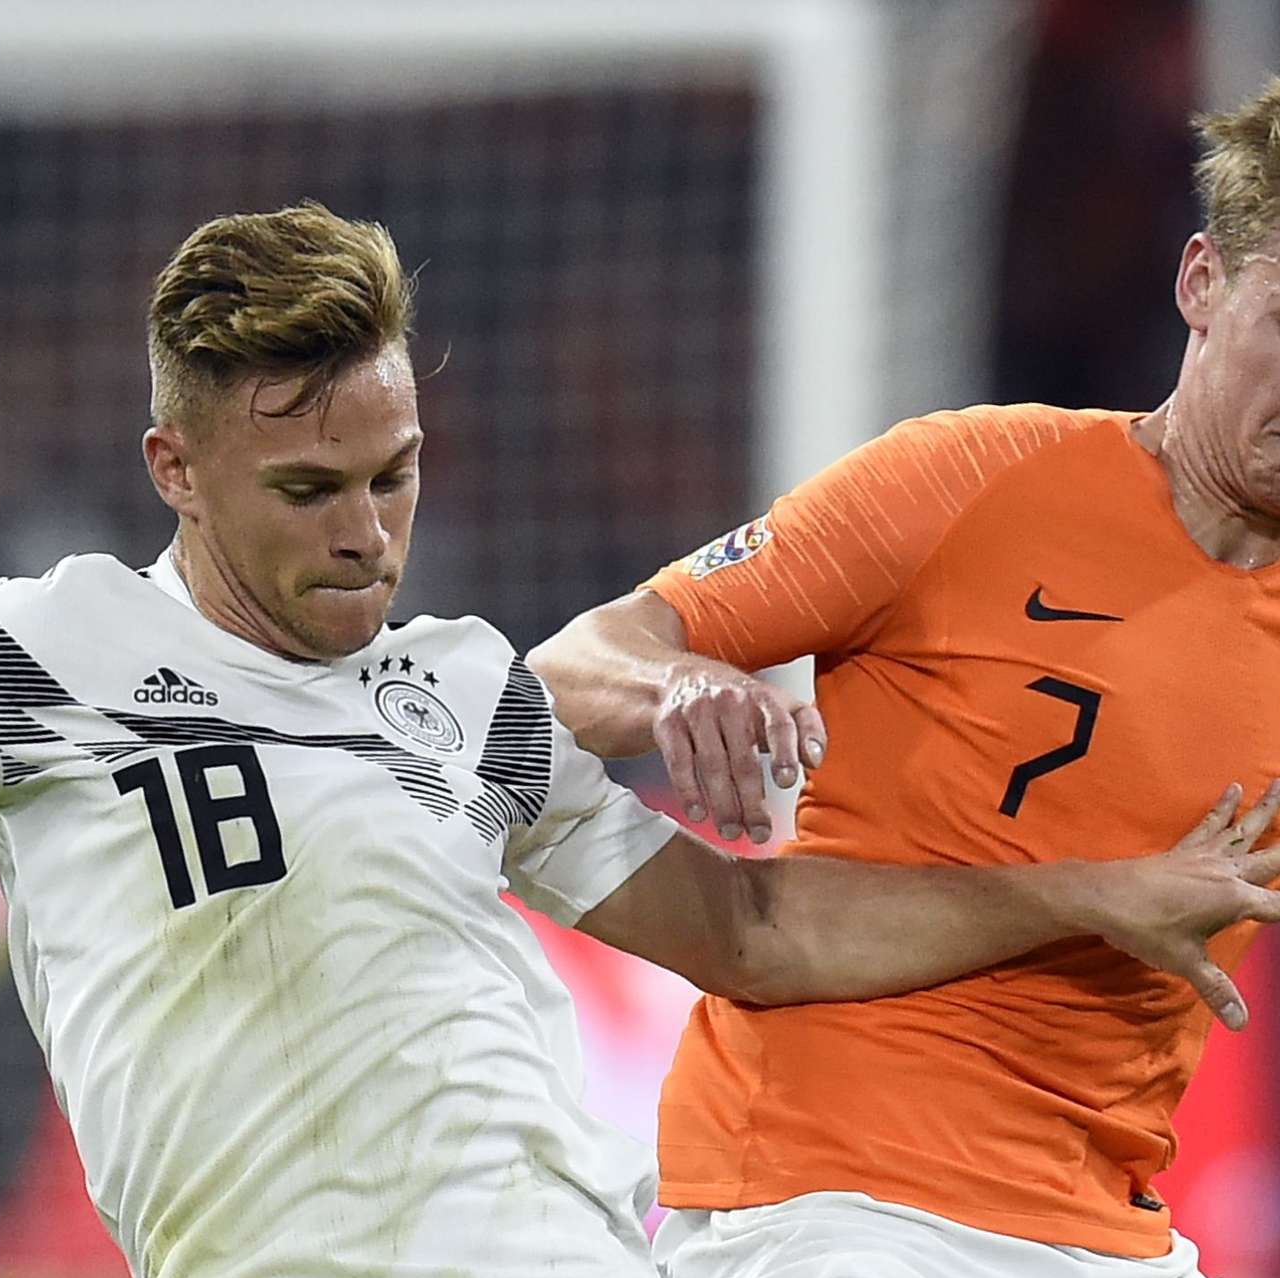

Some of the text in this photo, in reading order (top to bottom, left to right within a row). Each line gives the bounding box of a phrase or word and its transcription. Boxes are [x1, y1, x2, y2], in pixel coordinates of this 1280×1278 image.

[134, 685, 218, 706] adidas
[998, 676, 1102, 819] 7
[112, 744, 287, 910] 18
